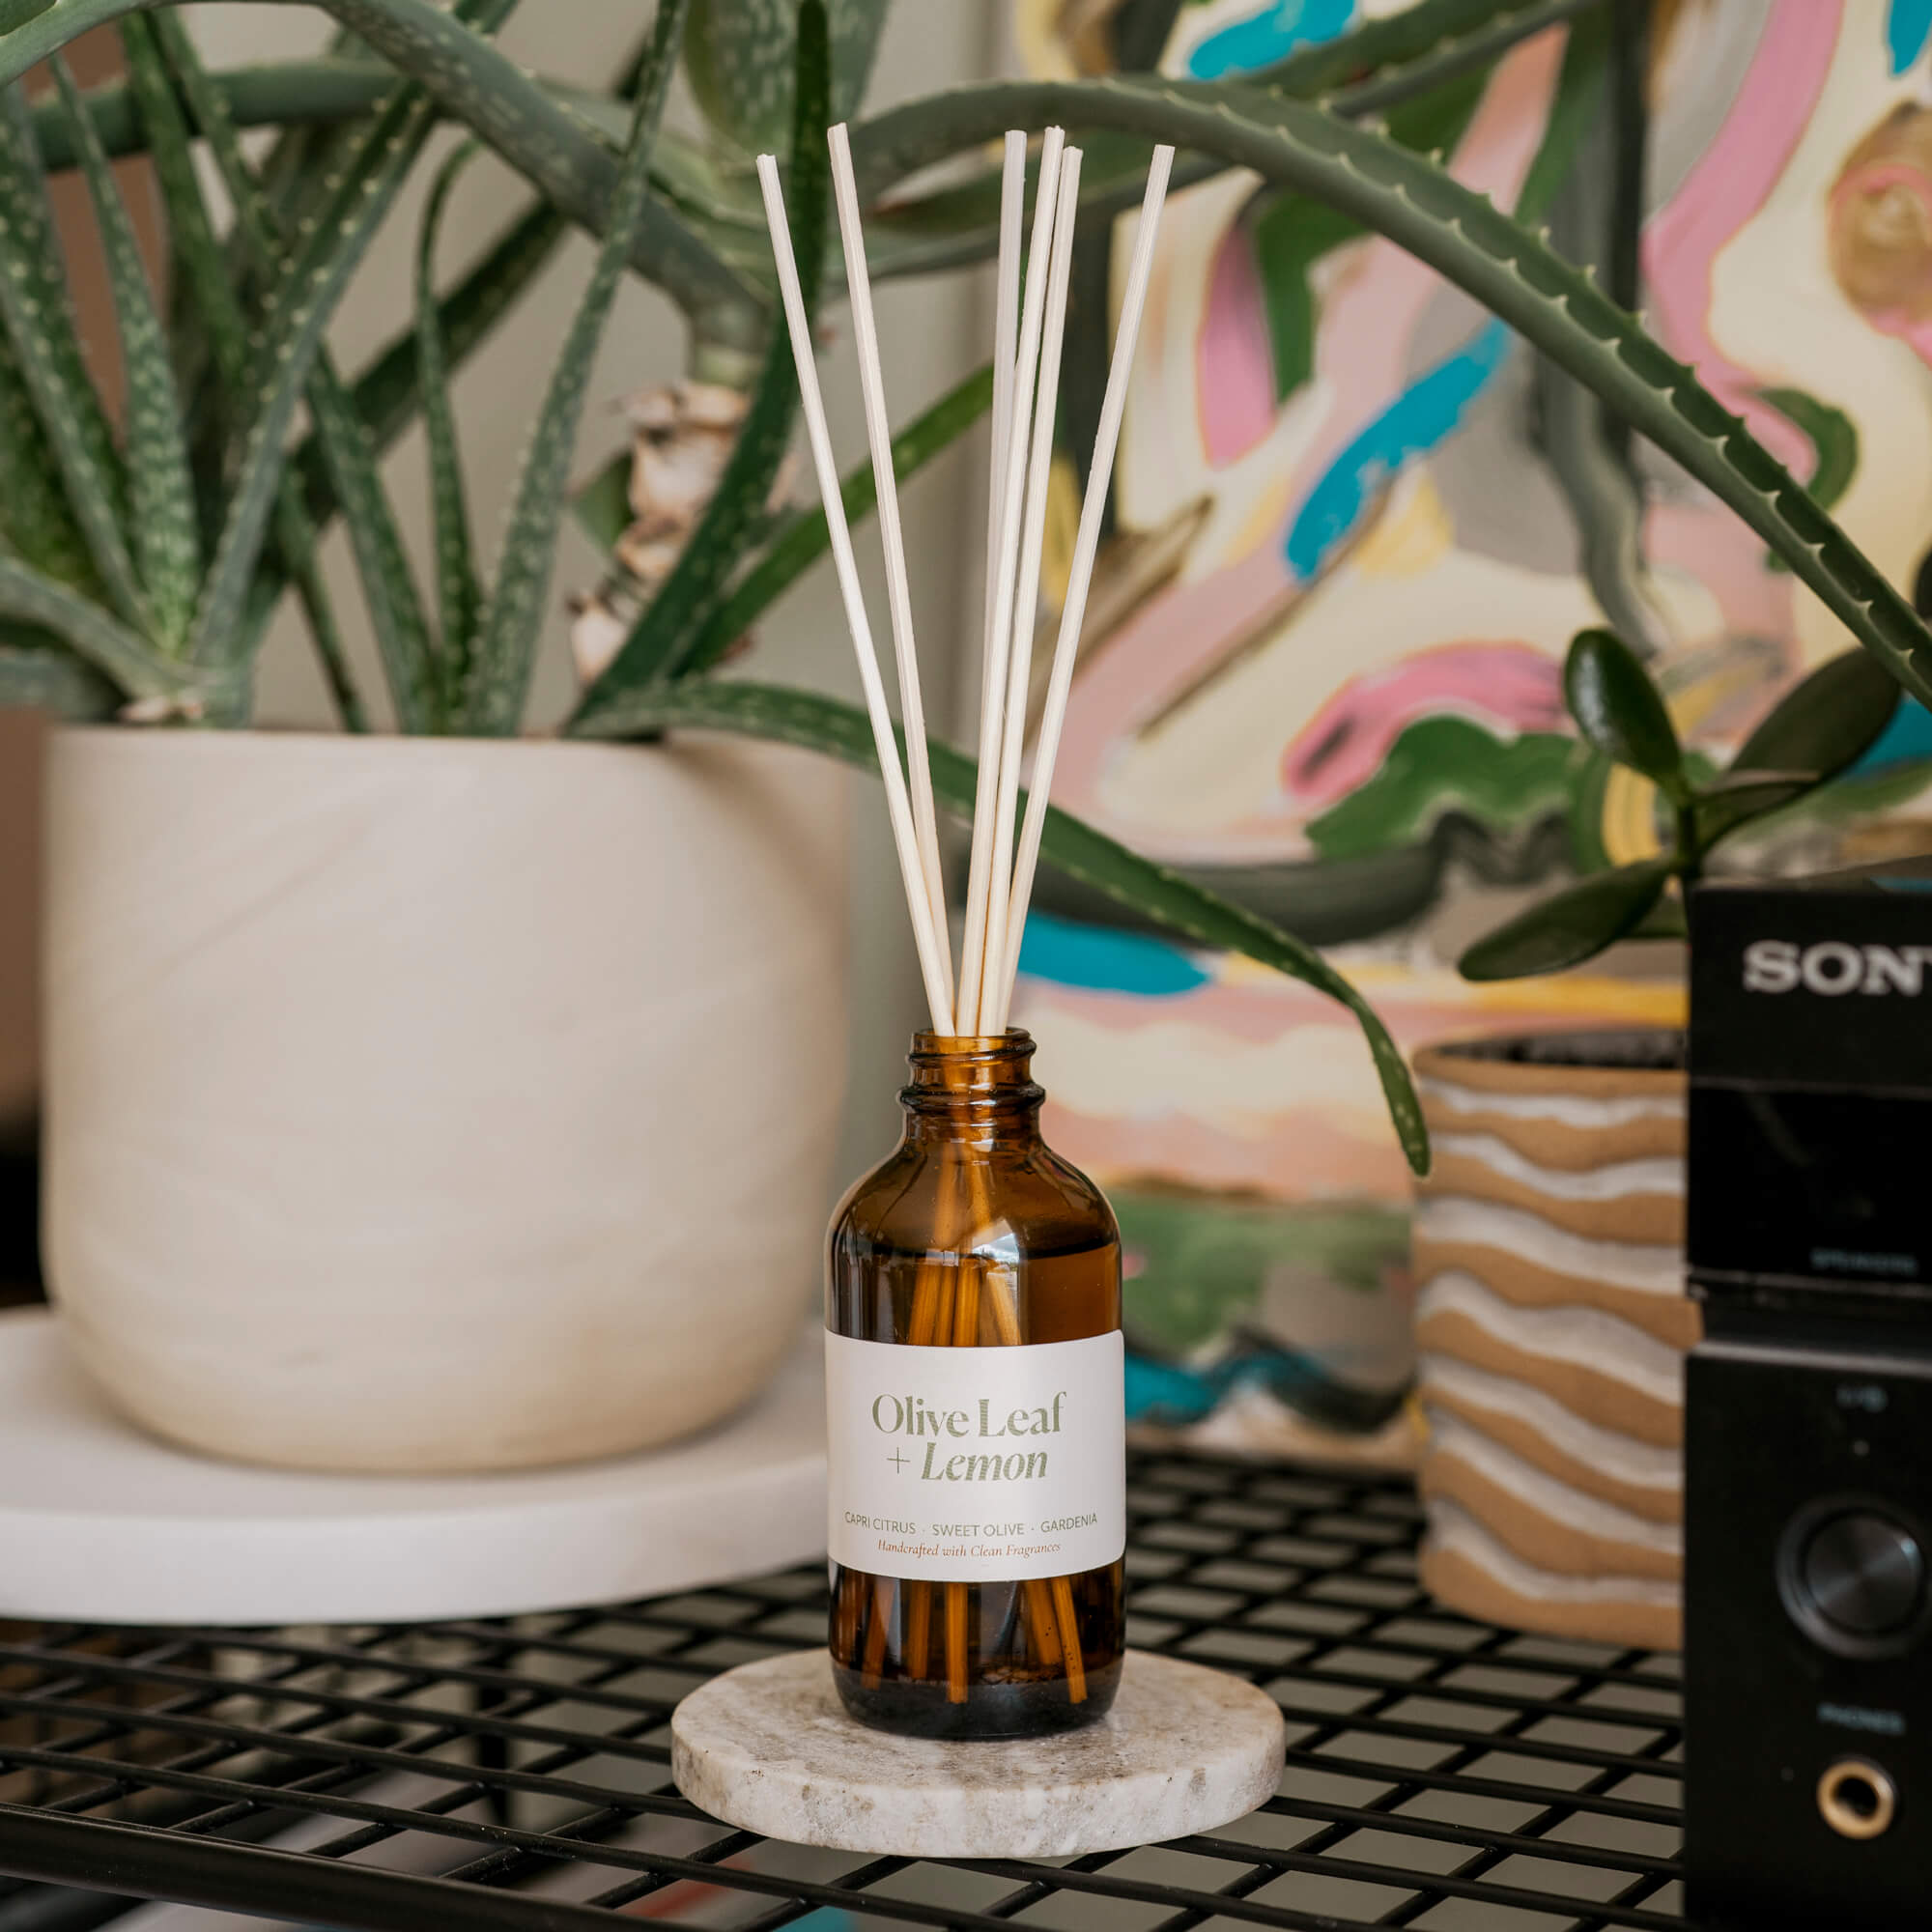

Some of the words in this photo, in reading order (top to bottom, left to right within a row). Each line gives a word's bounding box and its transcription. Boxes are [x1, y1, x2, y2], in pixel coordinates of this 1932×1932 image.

[1742, 940, 1932, 997] SON
[871, 1394, 969, 1437] Olive
[979, 1391, 1066, 1436] Leaf
[887, 1447, 910, 1473] +
[922, 1442, 1047, 1481] Lemon
[844, 1512, 870, 1528] CAPRI
[873, 1519, 916, 1534] CITRUS
[932, 1524, 980, 1537] SWEET
[983, 1523, 1024, 1537] OLIVE
[1041, 1513, 1097, 1533] GARDENIA
[877, 1539, 939, 1558] Handcrafted
[943, 1546, 966, 1556] with
[971, 1545, 1002, 1556] Clean
[1007, 1544, 1060, 1559] Fragrances
